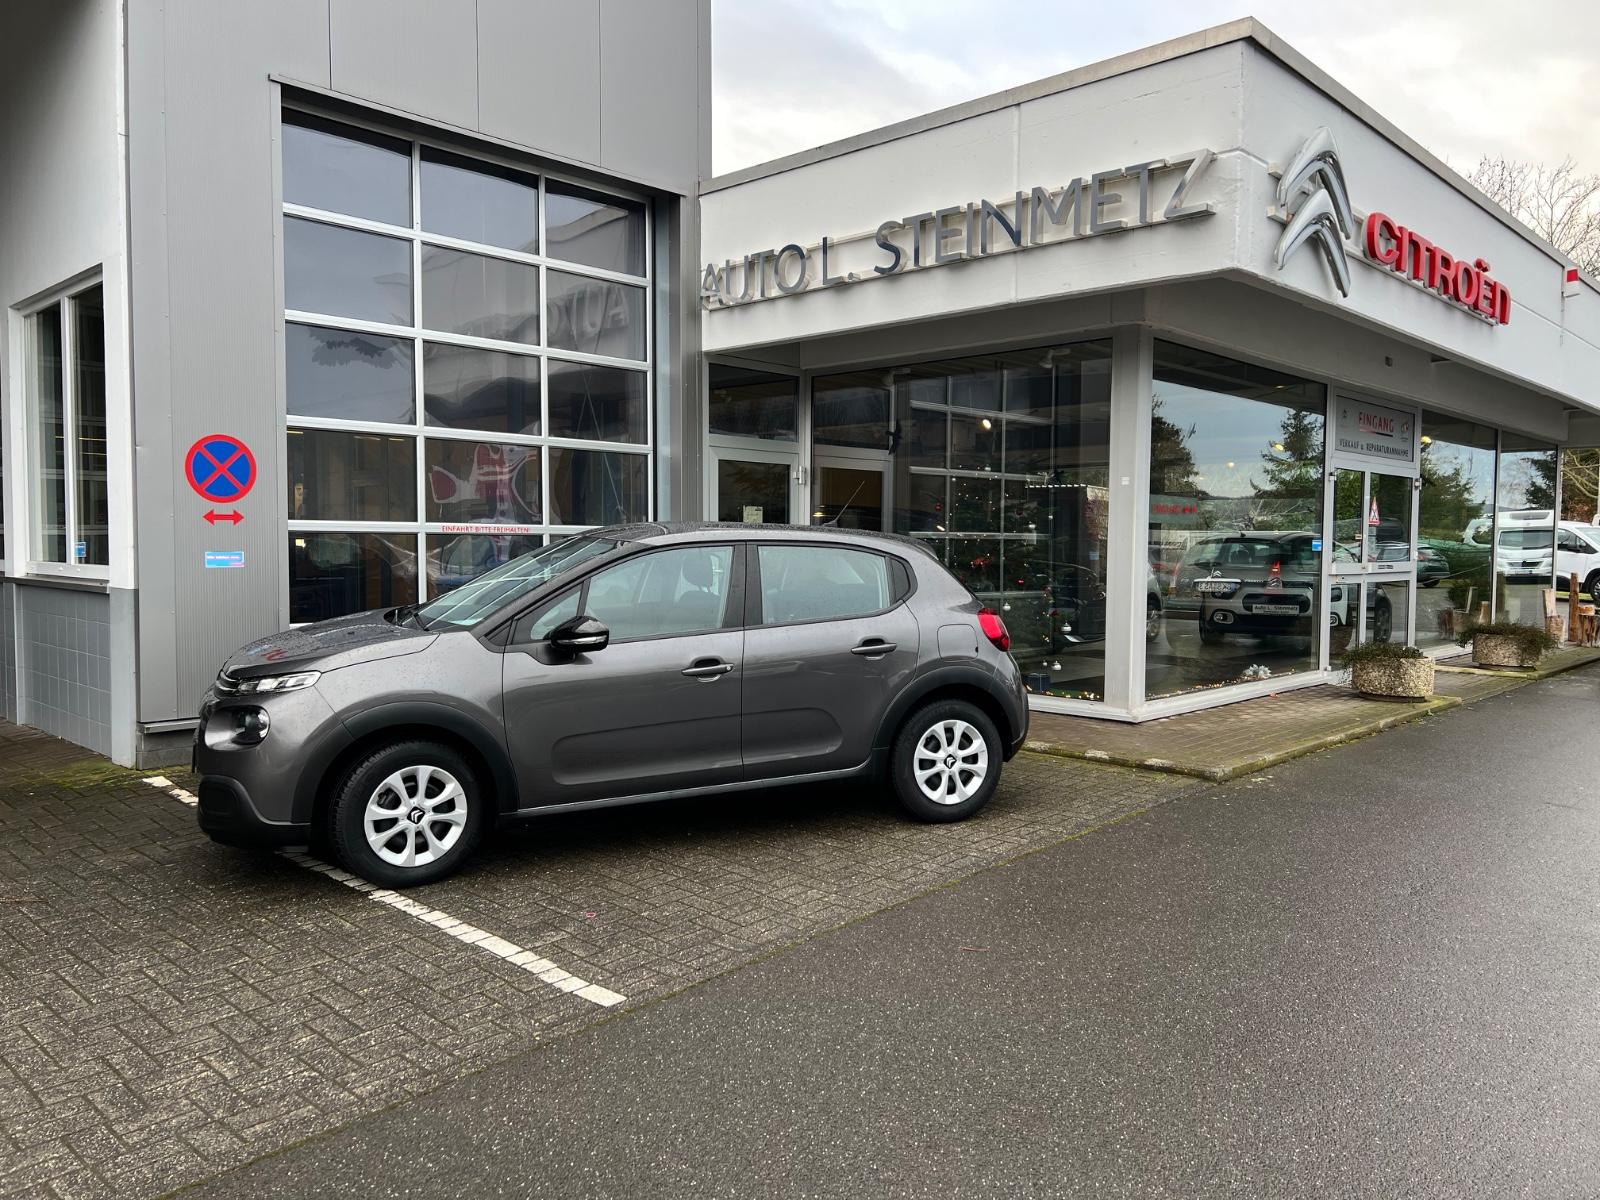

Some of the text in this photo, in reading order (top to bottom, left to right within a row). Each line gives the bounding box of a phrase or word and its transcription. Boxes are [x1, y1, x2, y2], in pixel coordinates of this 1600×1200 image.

[701, 148, 1216, 307] AUTO L. STEINMETZ
[1359, 411, 1394, 433] EINGANG
[442, 525, 473, 533] EINFAHRT
[493, 526, 529, 534] FREIHALTEN
